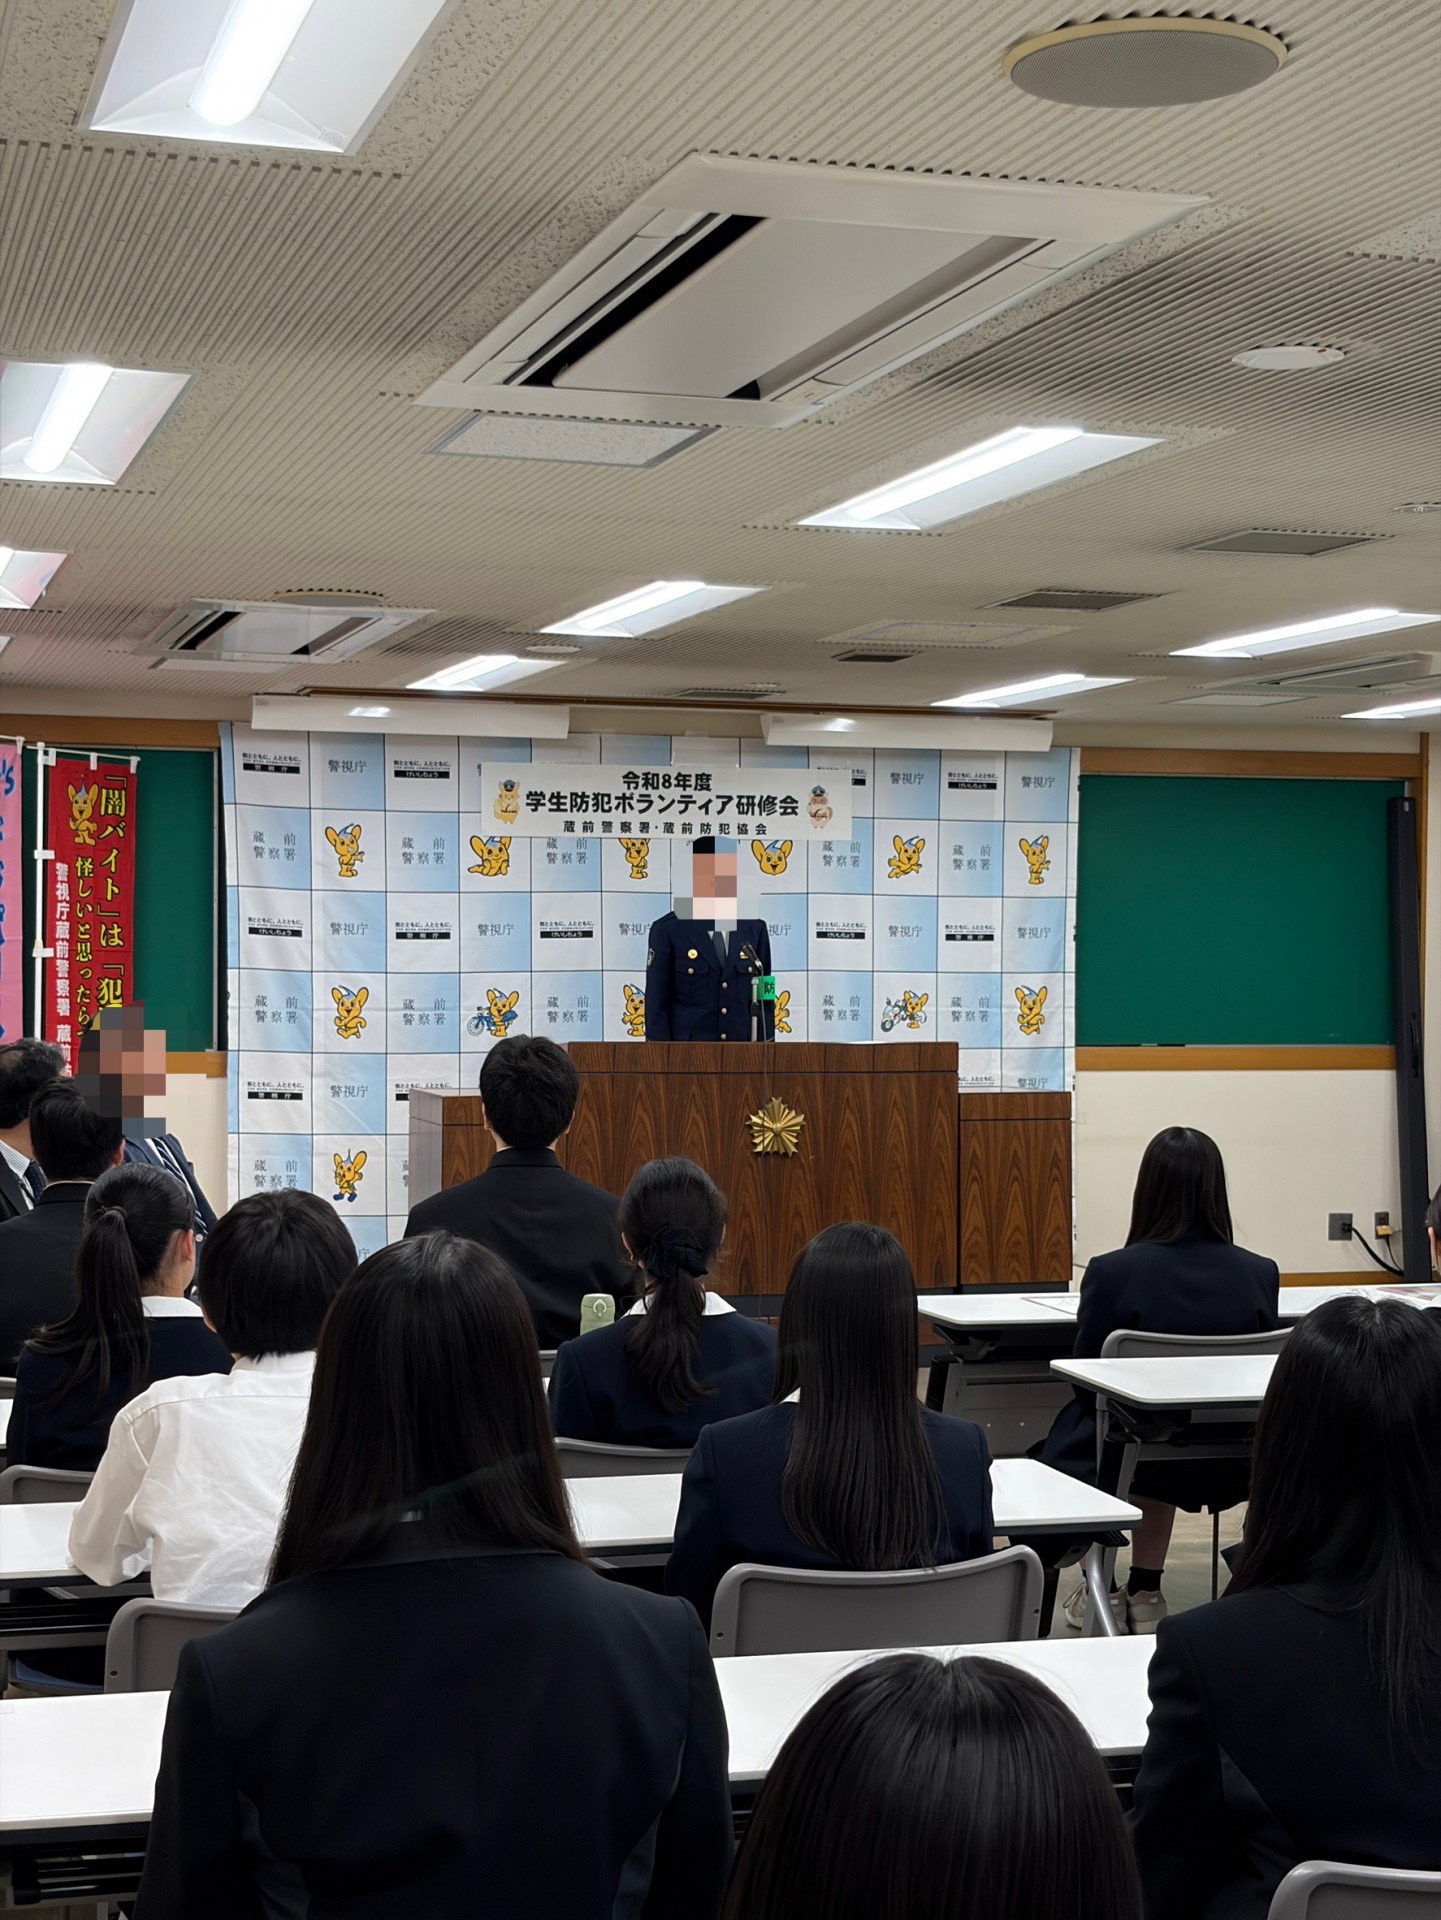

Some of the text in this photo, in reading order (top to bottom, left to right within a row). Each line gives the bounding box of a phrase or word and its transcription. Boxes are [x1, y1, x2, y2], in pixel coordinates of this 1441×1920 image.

[328, 760, 366, 773] 警視庁
[622, 771, 713, 791] 令和8年度
[890, 772, 924, 785] 警視庁
[1022, 776, 1055, 788] 警視庁
[526, 791, 799, 816] 学生防犯ボランティア研修会
[563, 820, 767, 836] 蔵前警察署・蔵前防犯協会
[252, 846, 297, 861] 警察署
[402, 852, 445, 864] 警察署
[546, 852, 587, 864] 警察署
[822, 855, 861, 868] 警察署
[953, 858, 990, 870] 警察署
[97, 774, 127, 1008] 「闇バイト」は「犯
[330, 922, 368, 935] 警視庁
[478, 923, 514, 936] 警視庁
[767, 923, 792, 937] 視庁
[888, 925, 922, 937] 警視庁
[1017, 927, 1051, 939] 警視庁
[55, 862, 70, 1016] 警視庁蔵前警察署
[74, 856, 95, 1036] 怪しいと思ったら
[763, 981, 775, 995] 防
[254, 1009, 298, 1024] 警察署
[402, 1012, 446, 1026] 警察署
[547, 1010, 589, 1023] 警察署
[823, 1009, 860, 1021] 警察署
[951, 1010, 989, 1022] 警察署
[330, 1085, 368, 1098] 警視庁
